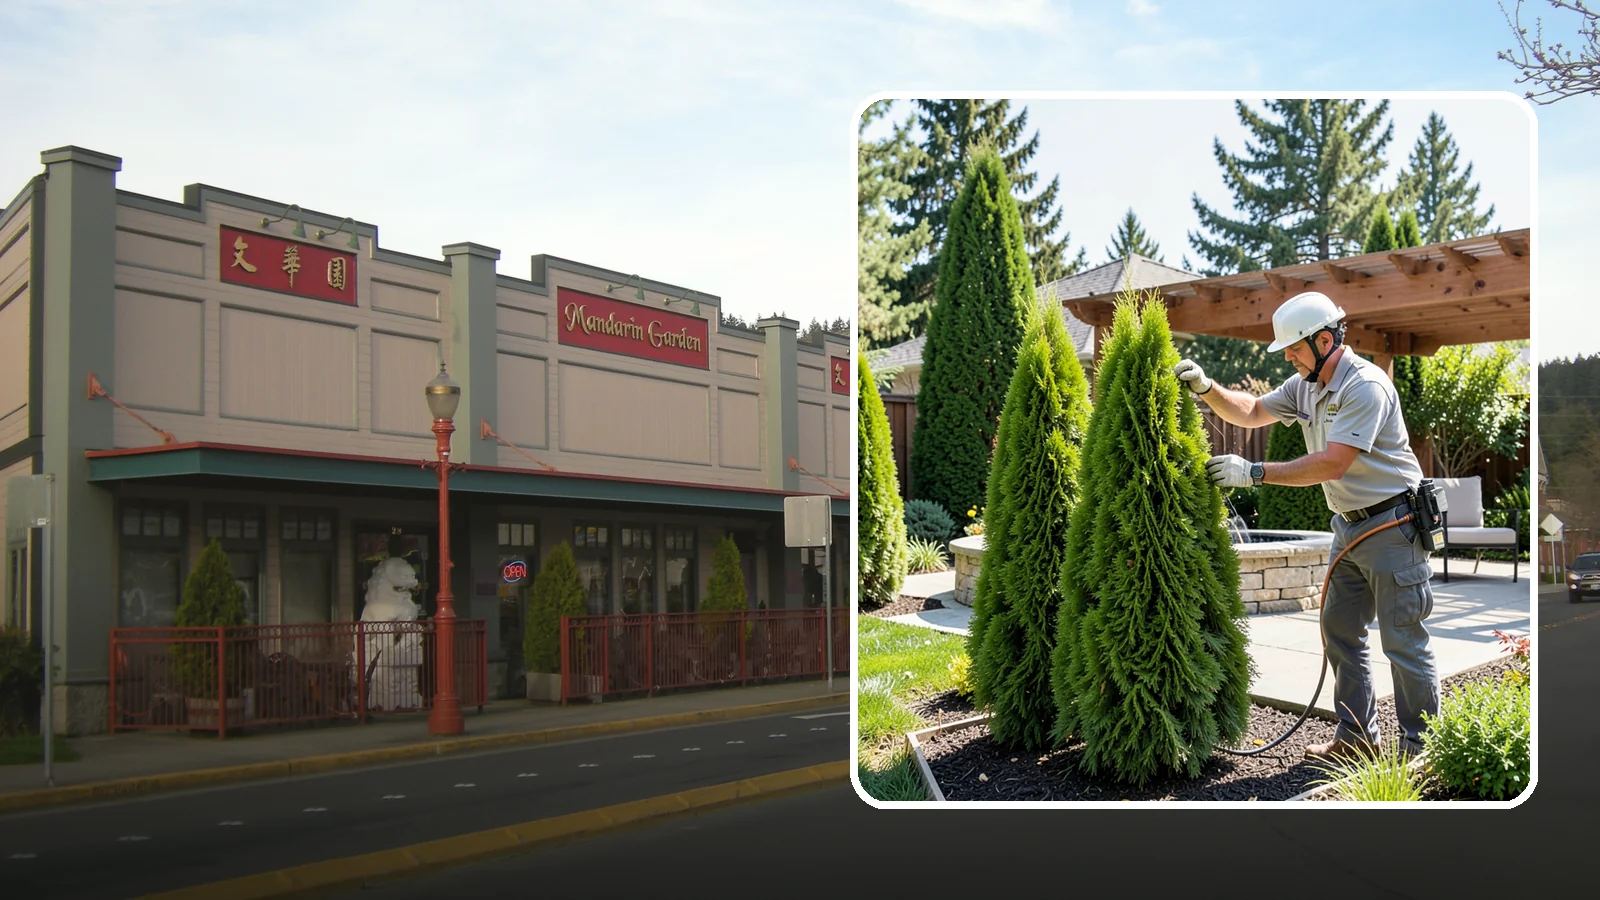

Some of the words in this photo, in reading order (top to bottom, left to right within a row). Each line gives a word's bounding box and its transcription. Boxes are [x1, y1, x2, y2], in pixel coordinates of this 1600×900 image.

[231, 235, 346, 291] 文華園
[564, 302, 644, 341] Mandarin
[648, 320, 702, 352] Garden
[503, 565, 527, 578] OPEN
